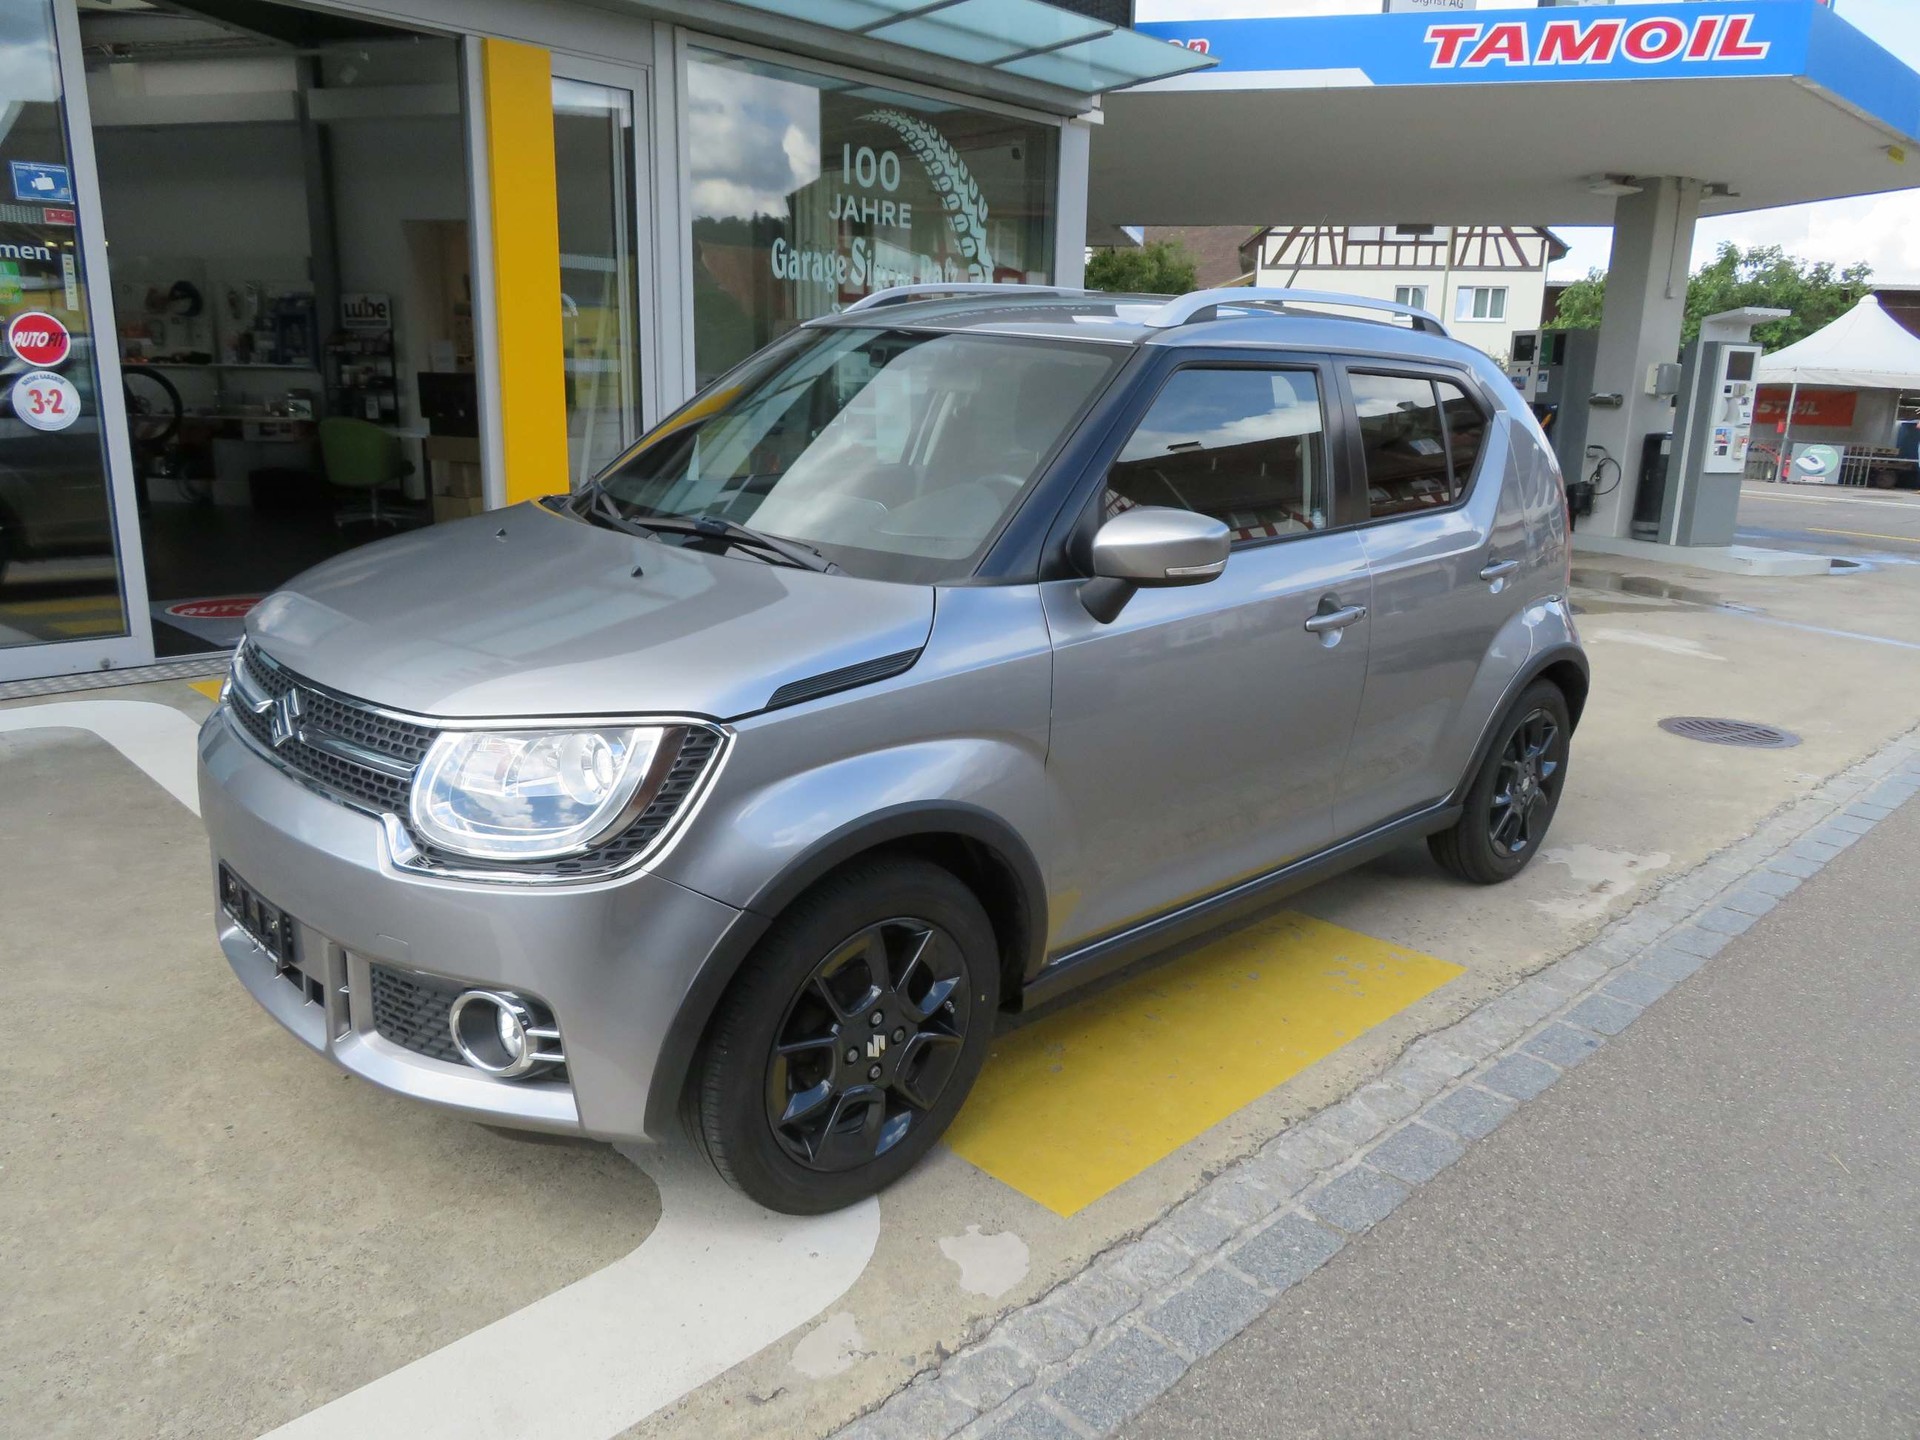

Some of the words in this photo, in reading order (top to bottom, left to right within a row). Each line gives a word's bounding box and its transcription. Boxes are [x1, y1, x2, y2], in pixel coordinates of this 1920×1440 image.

[1424, 14, 1771, 69] TAMOIL
[843, 143, 900, 191] 100
[828, 193, 912, 229] JAHRE
[0, 244, 51, 260] men
[771, 237, 847, 293] Garage
[28, 389, 64, 414] 3+2
